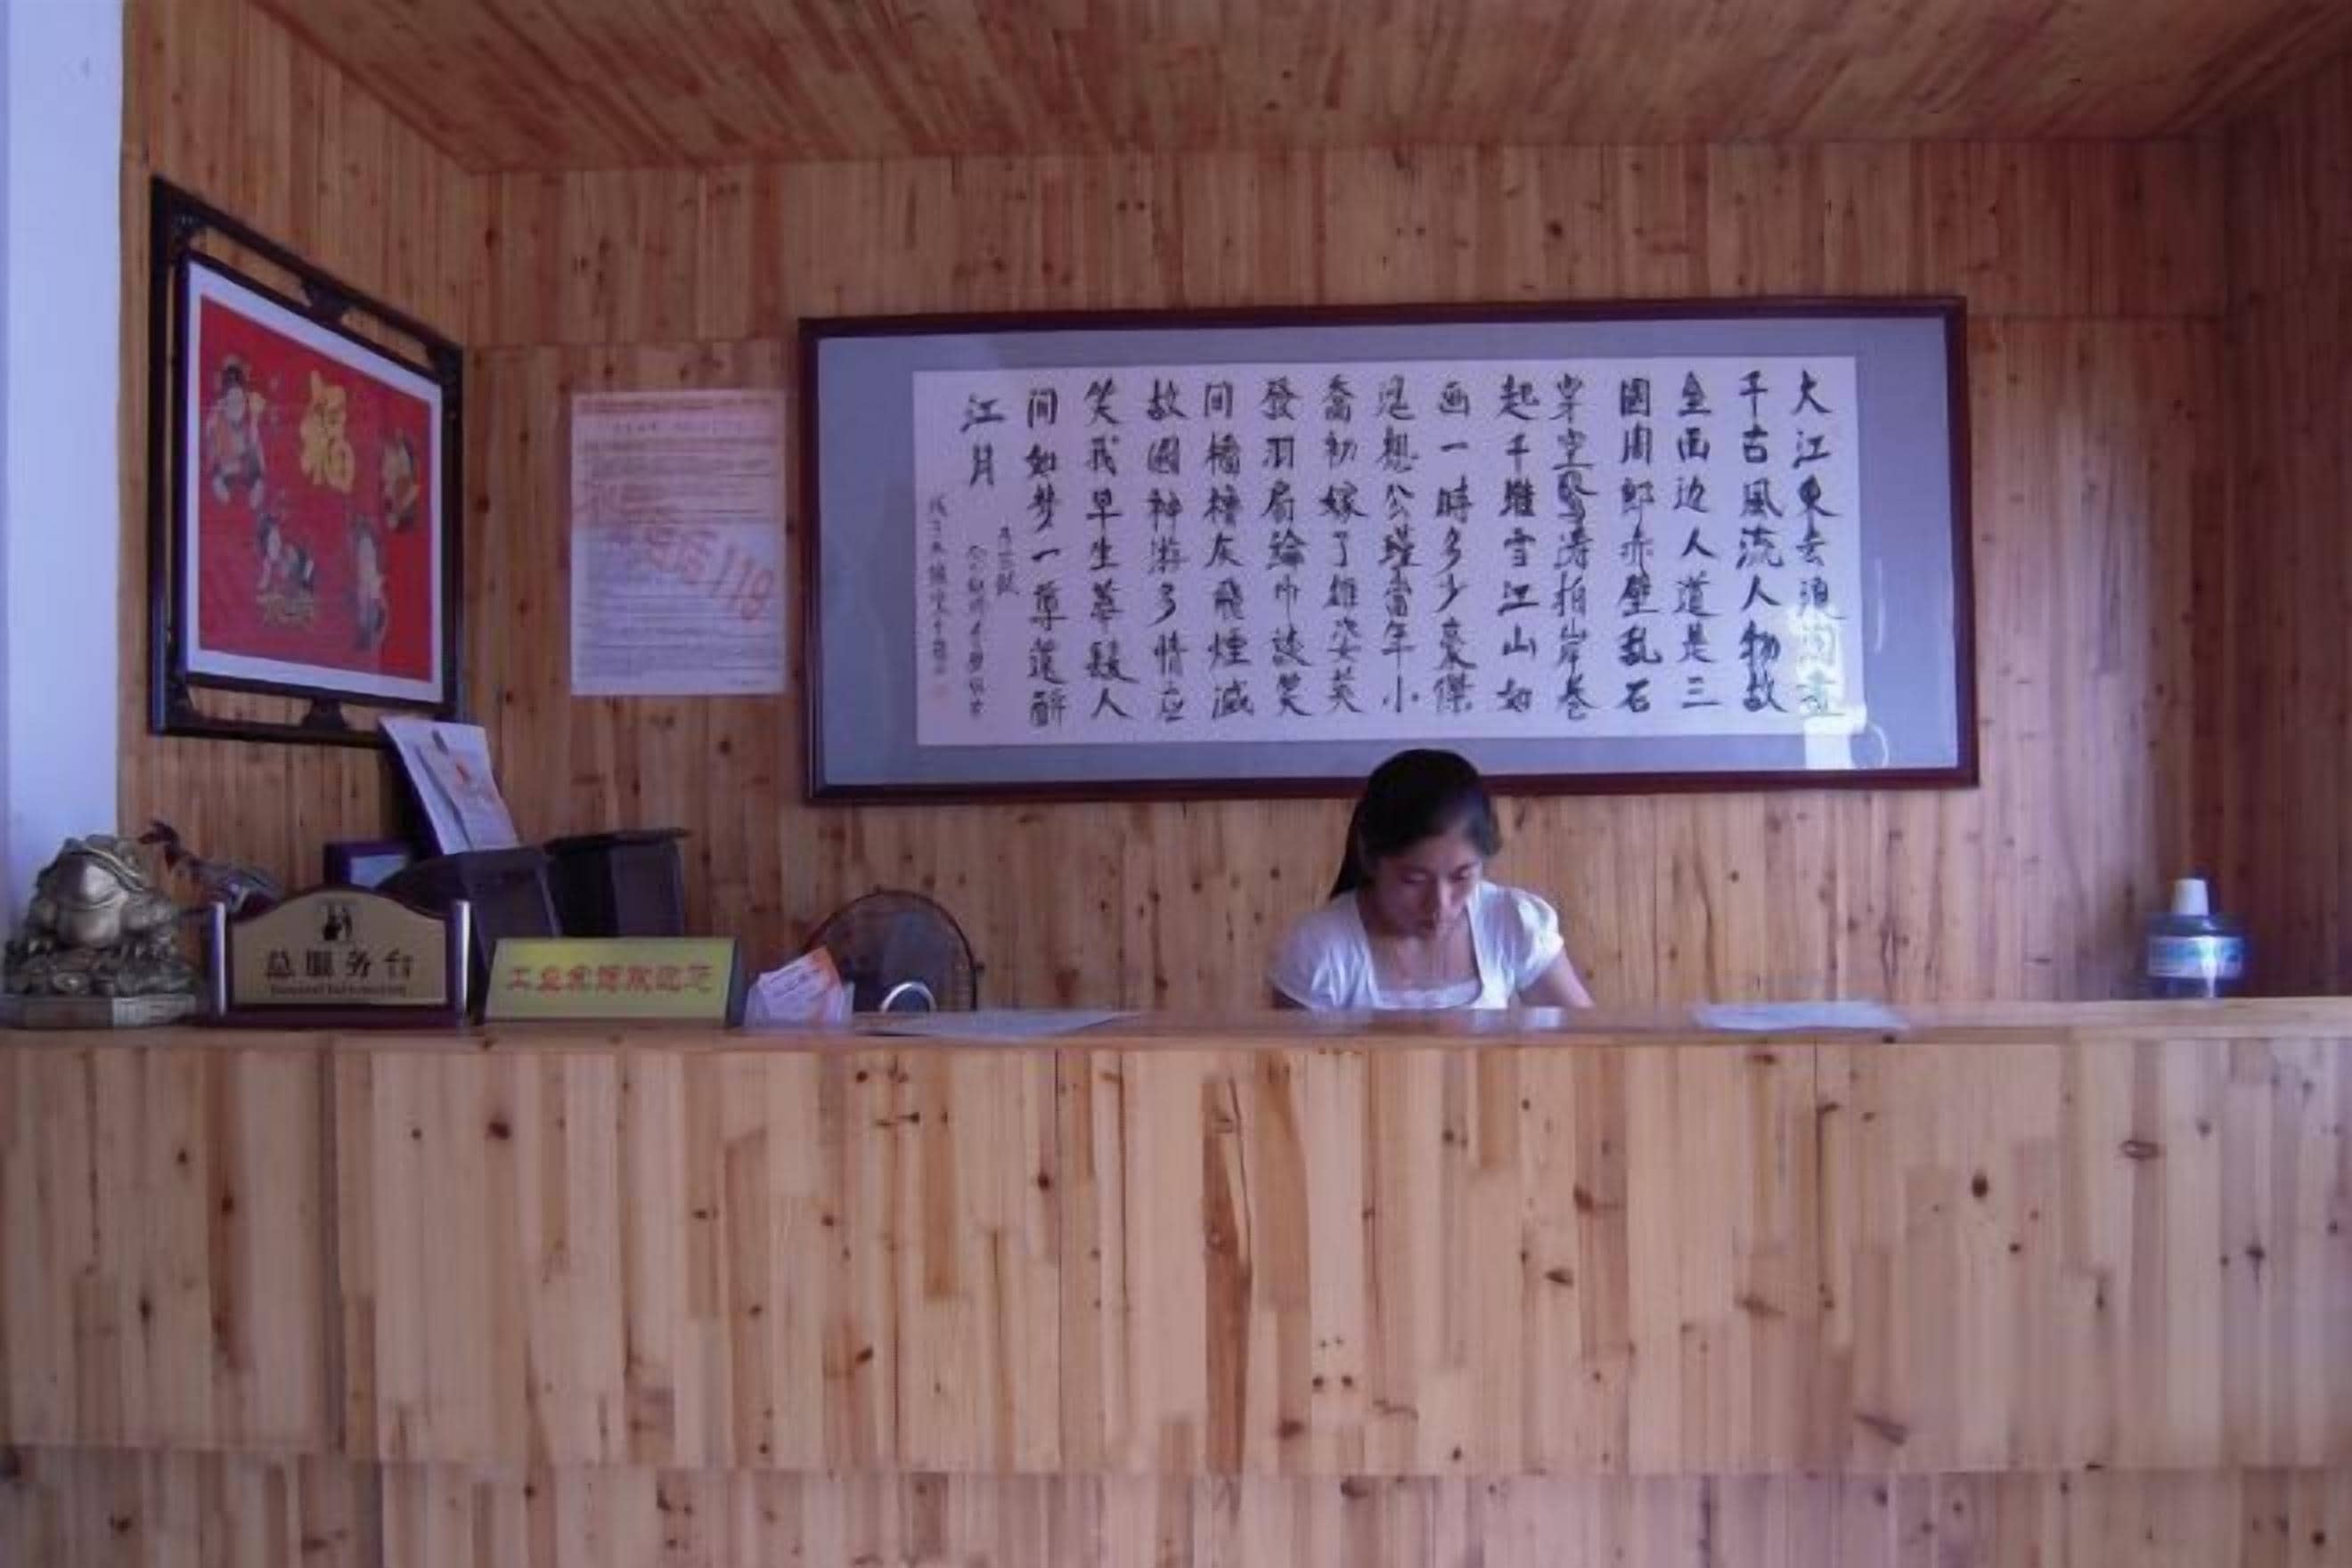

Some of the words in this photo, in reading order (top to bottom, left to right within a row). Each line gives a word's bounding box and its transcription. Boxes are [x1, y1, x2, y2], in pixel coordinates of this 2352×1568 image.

[960, 395, 1005, 487] 江月
[1495, 373, 1539, 713] 起千堆雪江山如
[1735, 370, 1785, 713] 千古風流人物故
